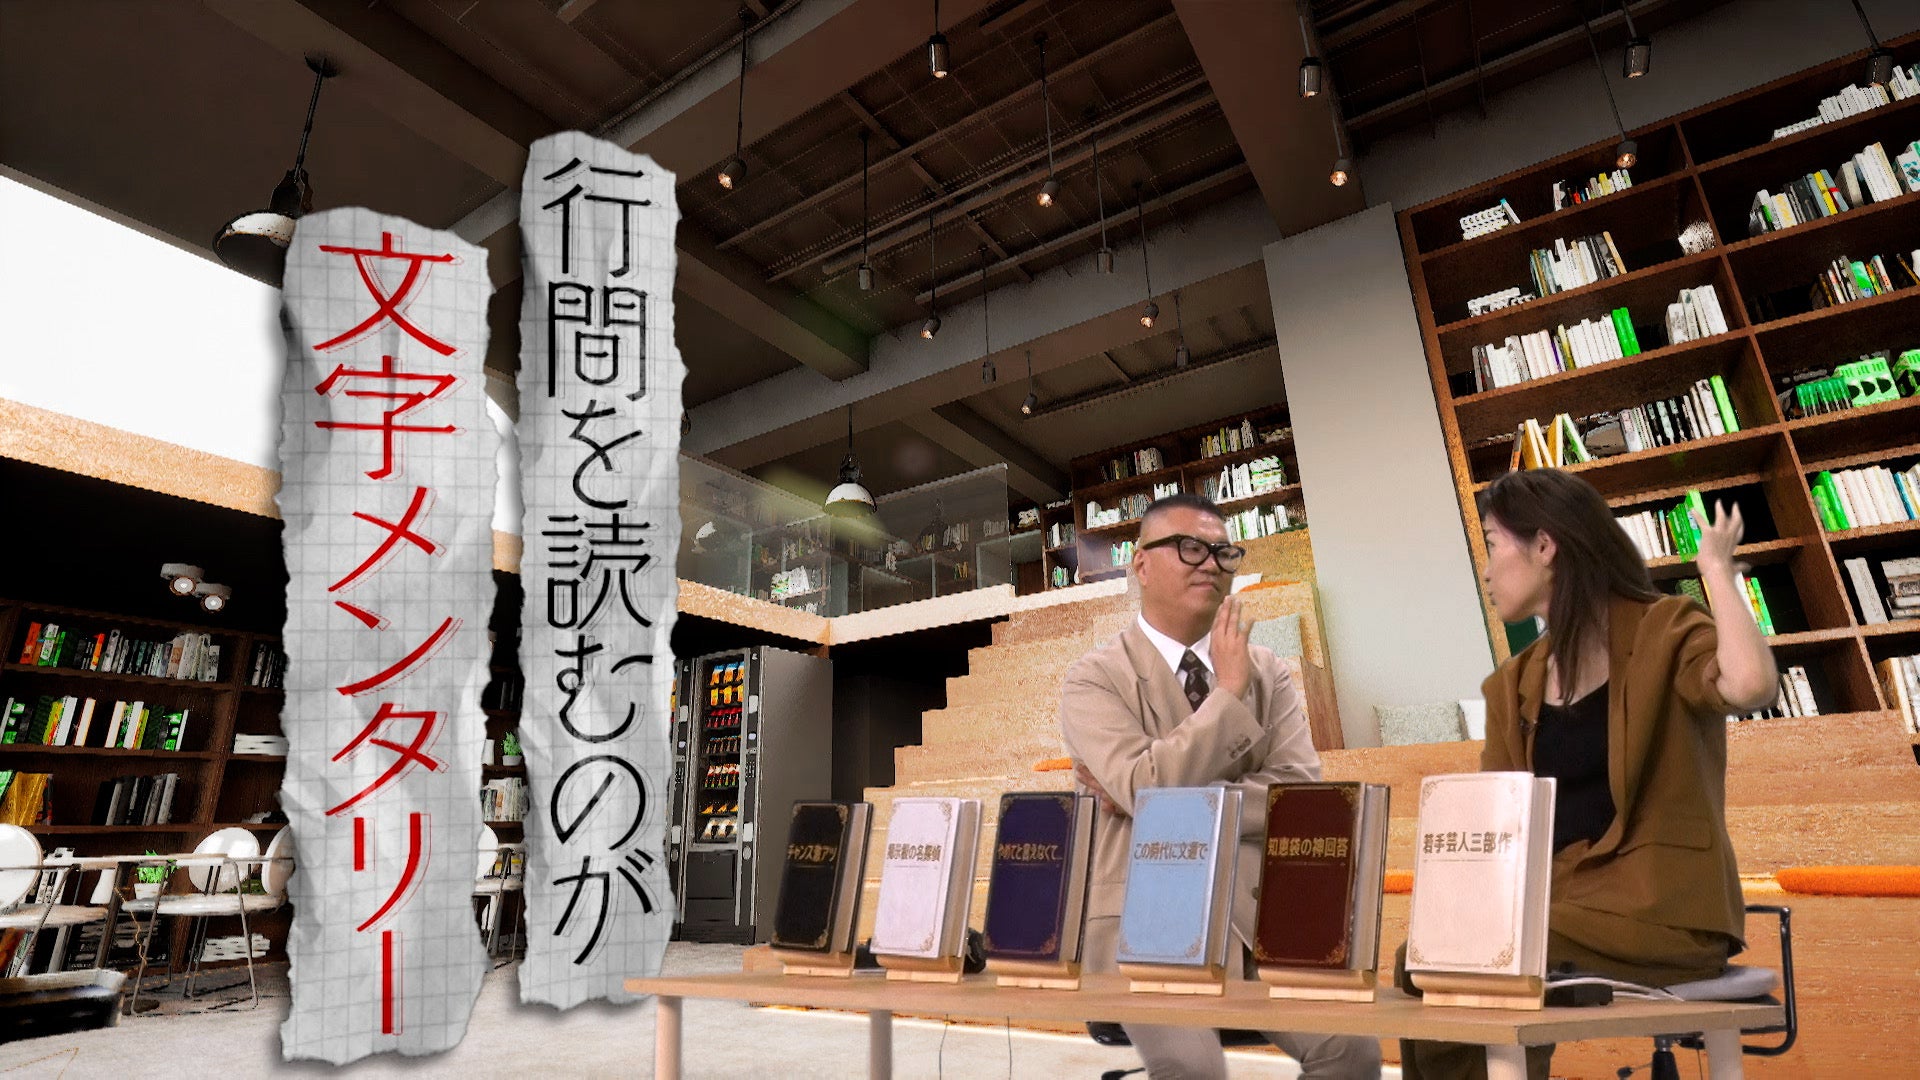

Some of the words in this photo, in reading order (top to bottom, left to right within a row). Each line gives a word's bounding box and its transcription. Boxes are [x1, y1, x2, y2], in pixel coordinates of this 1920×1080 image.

[1267, 837, 1349, 858] 知恵袋の神回答
[1422, 832, 1513, 854] 若手芸人三部作
